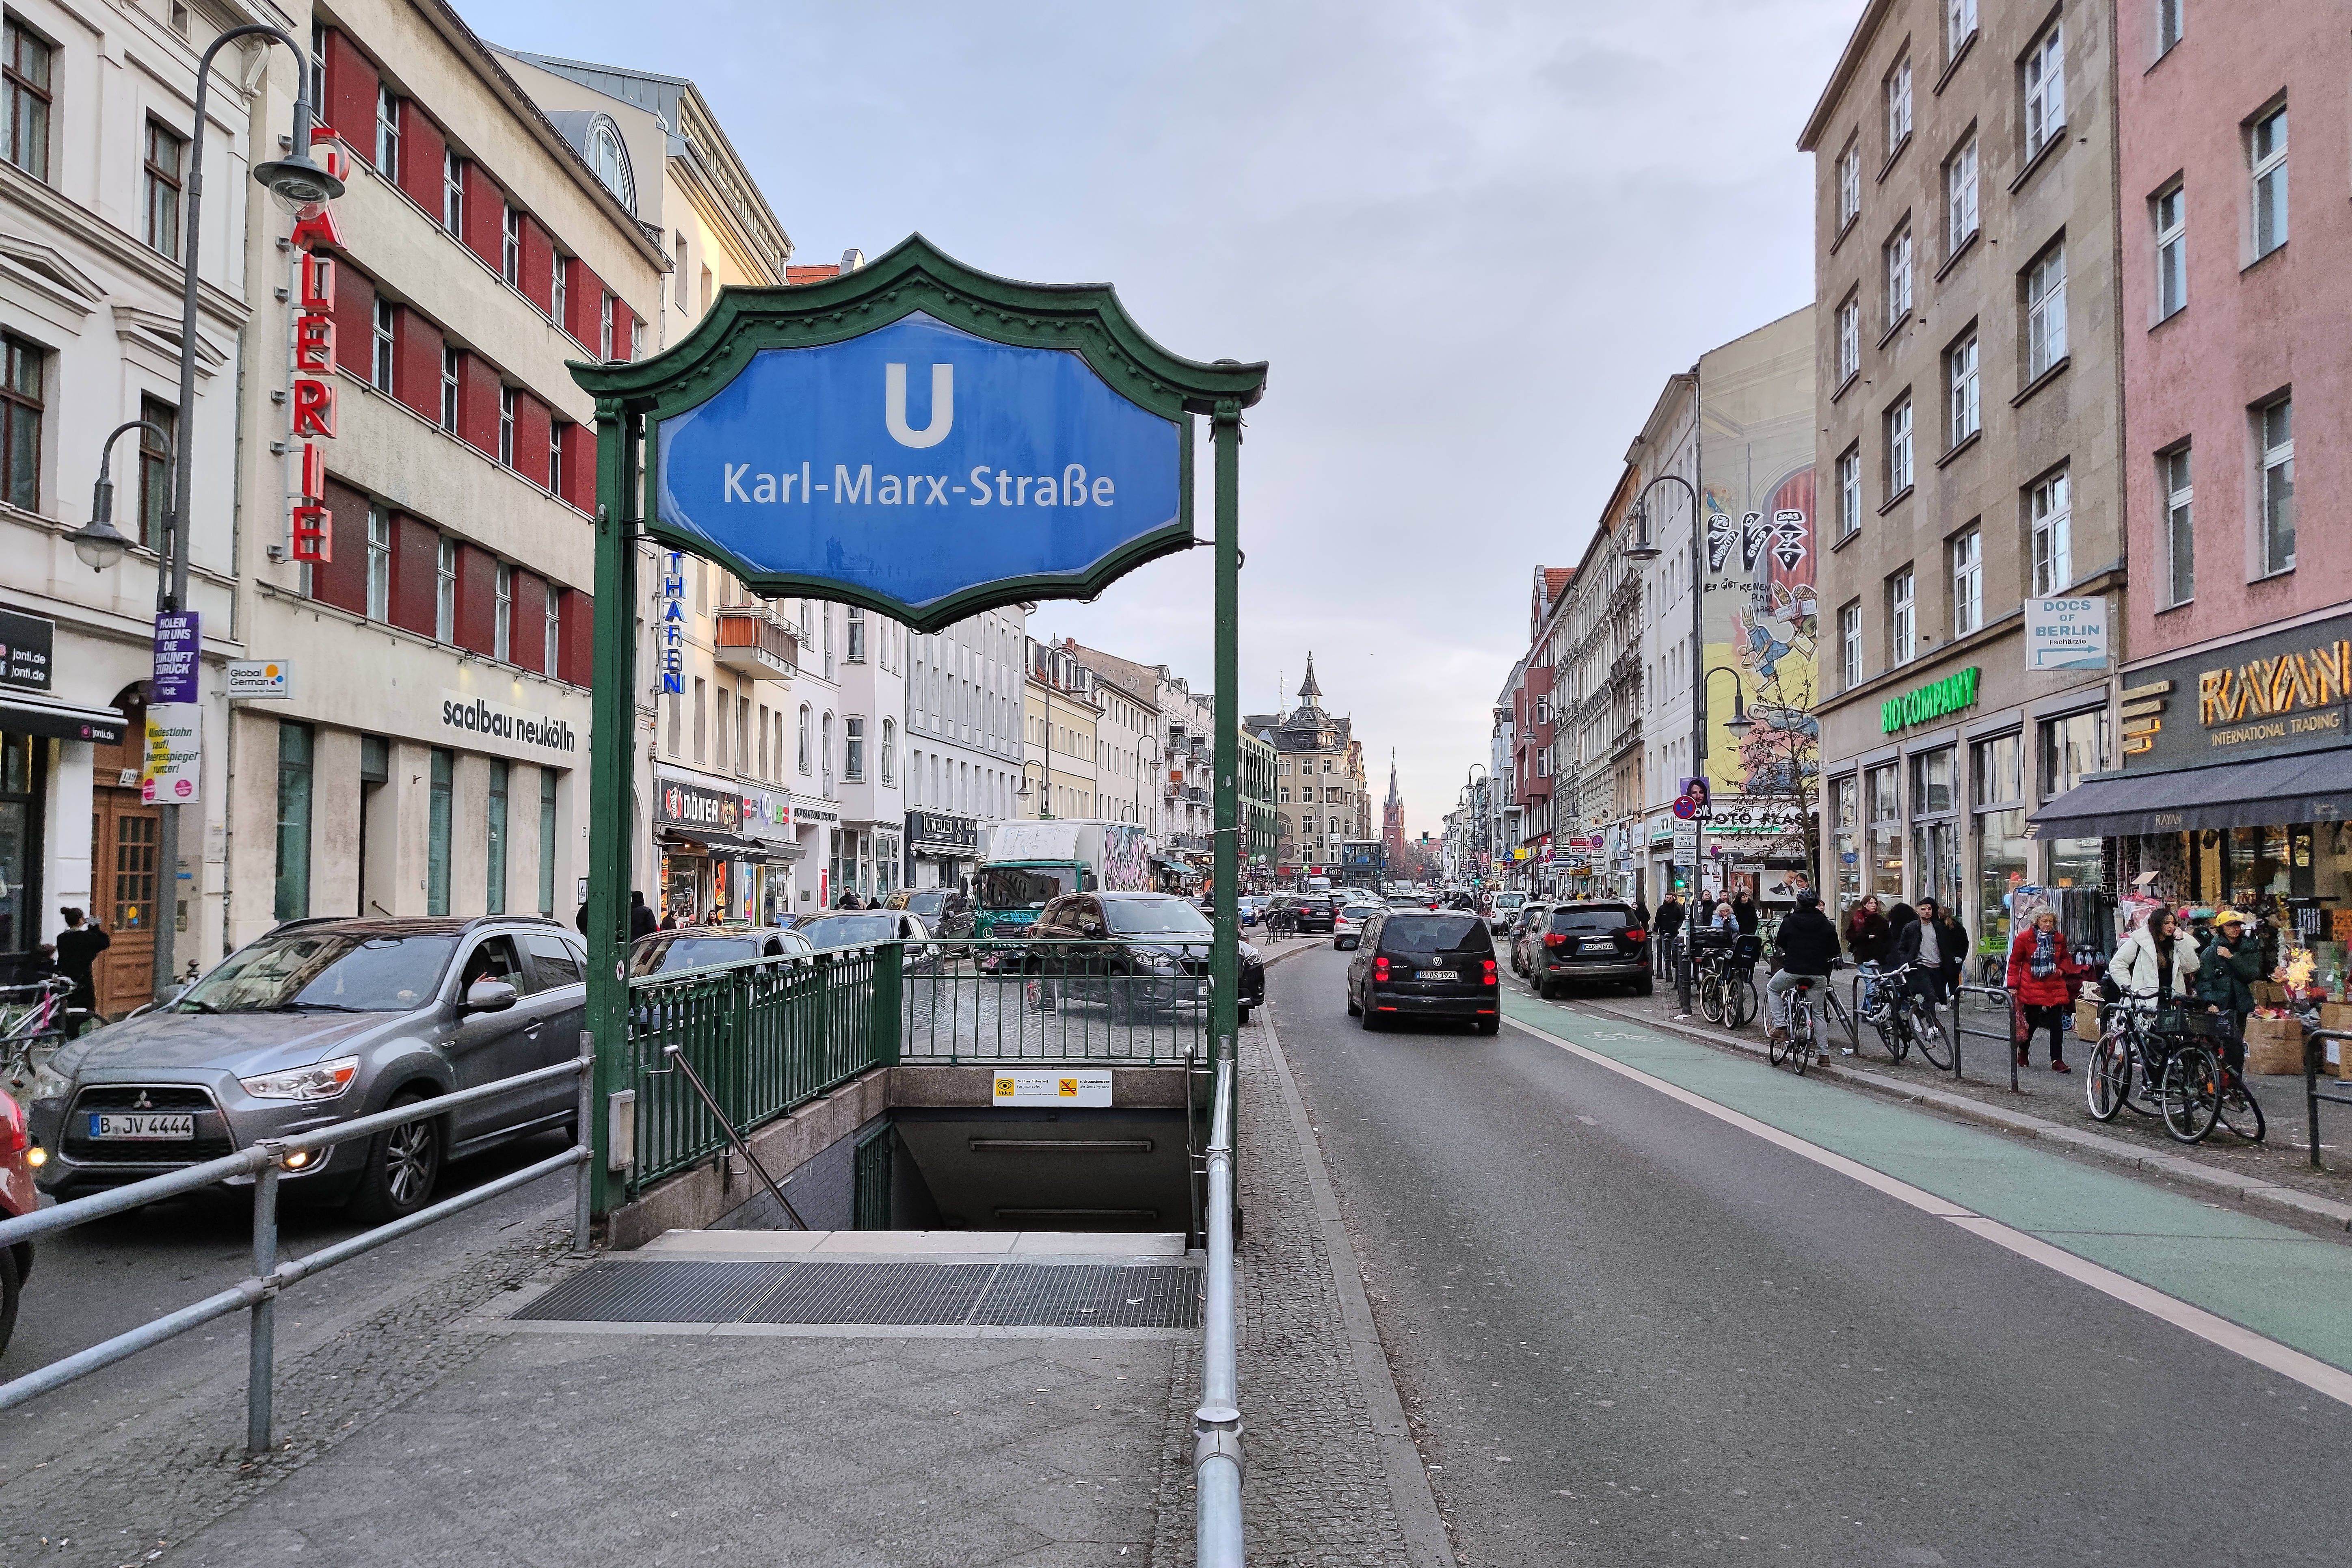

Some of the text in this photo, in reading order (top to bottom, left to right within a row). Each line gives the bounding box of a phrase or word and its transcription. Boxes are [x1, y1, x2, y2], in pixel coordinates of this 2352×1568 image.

[886, 363, 953, 448] U
[724, 461, 1115, 507] Karl-Marx-Straße
[1751, 593, 1773, 603] PLAN
[2044, 600, 2091, 612] DOCS
[160, 617, 187, 629] HOLEN
[158, 629, 191, 640] WIR UNS
[2036, 624, 2100, 636] BERLIN
[164, 640, 179, 651] DIE
[155, 652, 195, 663] ZUKUNFT
[230, 669, 262, 677] Global
[2199, 639, 2350, 726] RAYAN
[1881, 666, 1980, 733] BIO COMPANY
[443, 699, 574, 753] saalbau neukölln
[2211, 712, 2341, 746] INTERNATIONAL TRADING
[153, 739, 169, 749] rauf!
[153, 764, 180, 774] runter!
[683, 791, 718, 823] DÖNER
[1695, 805, 1711, 817] olt
[2155, 813, 2182, 826] RAYAN
[923, 814, 977, 838] JUWELIER GOLD
[1345, 845, 1351, 853] U
[102, 1118, 190, 1133] B JV 4444
